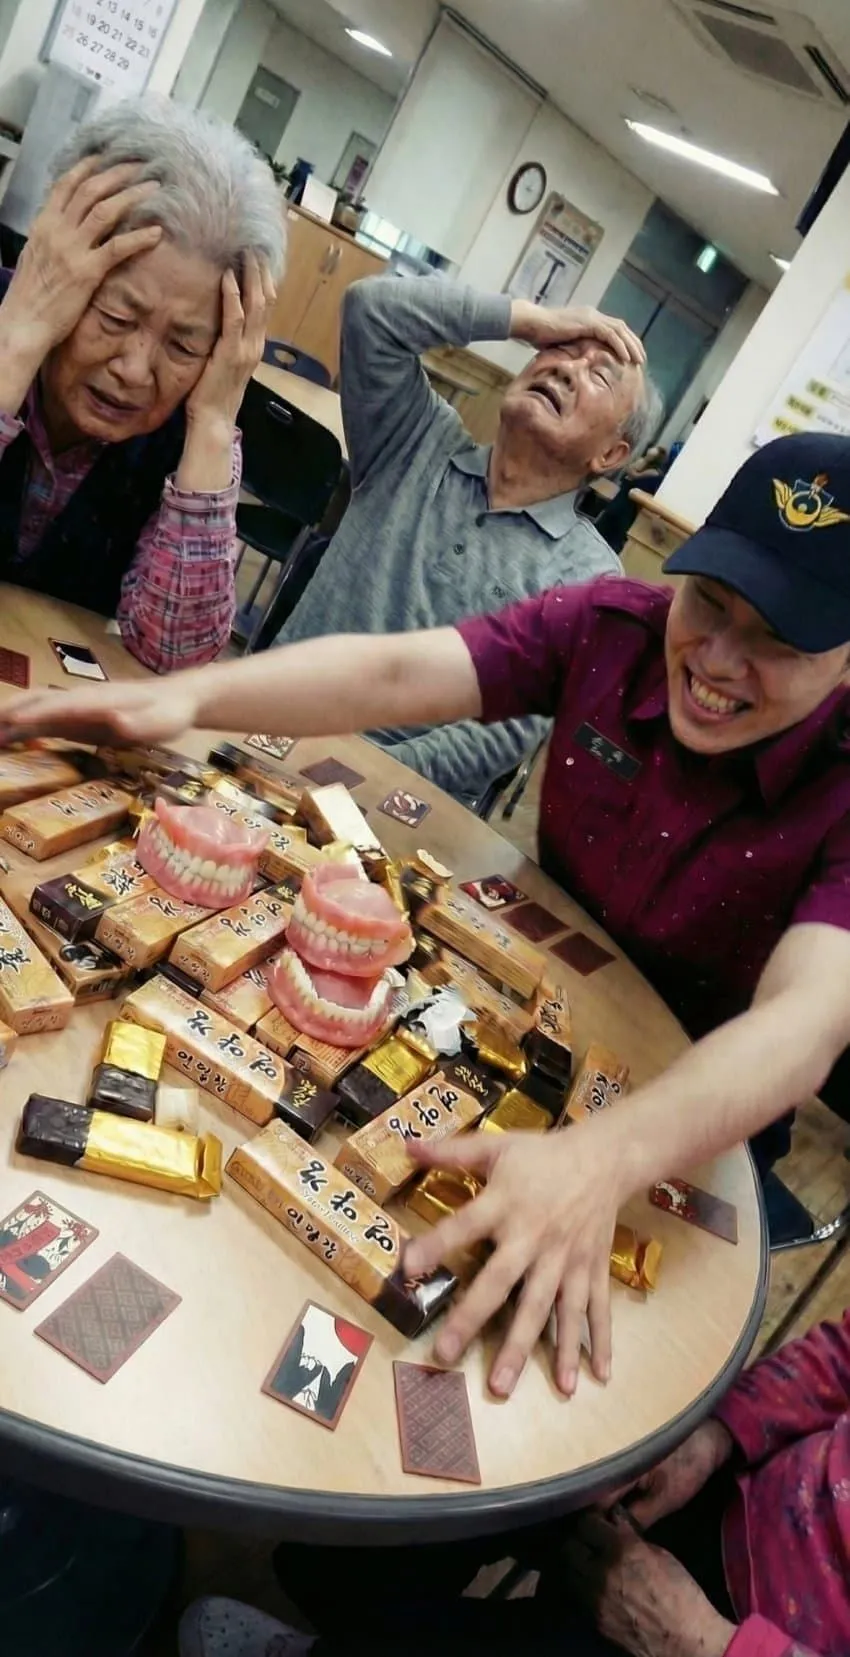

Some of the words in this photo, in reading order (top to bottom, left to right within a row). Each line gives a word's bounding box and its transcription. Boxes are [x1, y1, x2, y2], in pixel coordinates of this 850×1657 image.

[86, 13, 97, 25] 19
[97, 20, 110, 34] 20
[111, 28, 123, 41] 21
[125, 36, 137, 50] 22
[107, 1, 118, 14] 13
[120, 9, 131, 22] 14
[134, 18, 145, 31] 15
[148, 26, 158, 38] 16
[76, 32, 89, 46] 26
[90, 41, 104, 53] 27
[104, 48, 116, 62] 28
[117, 57, 130, 70] 29
